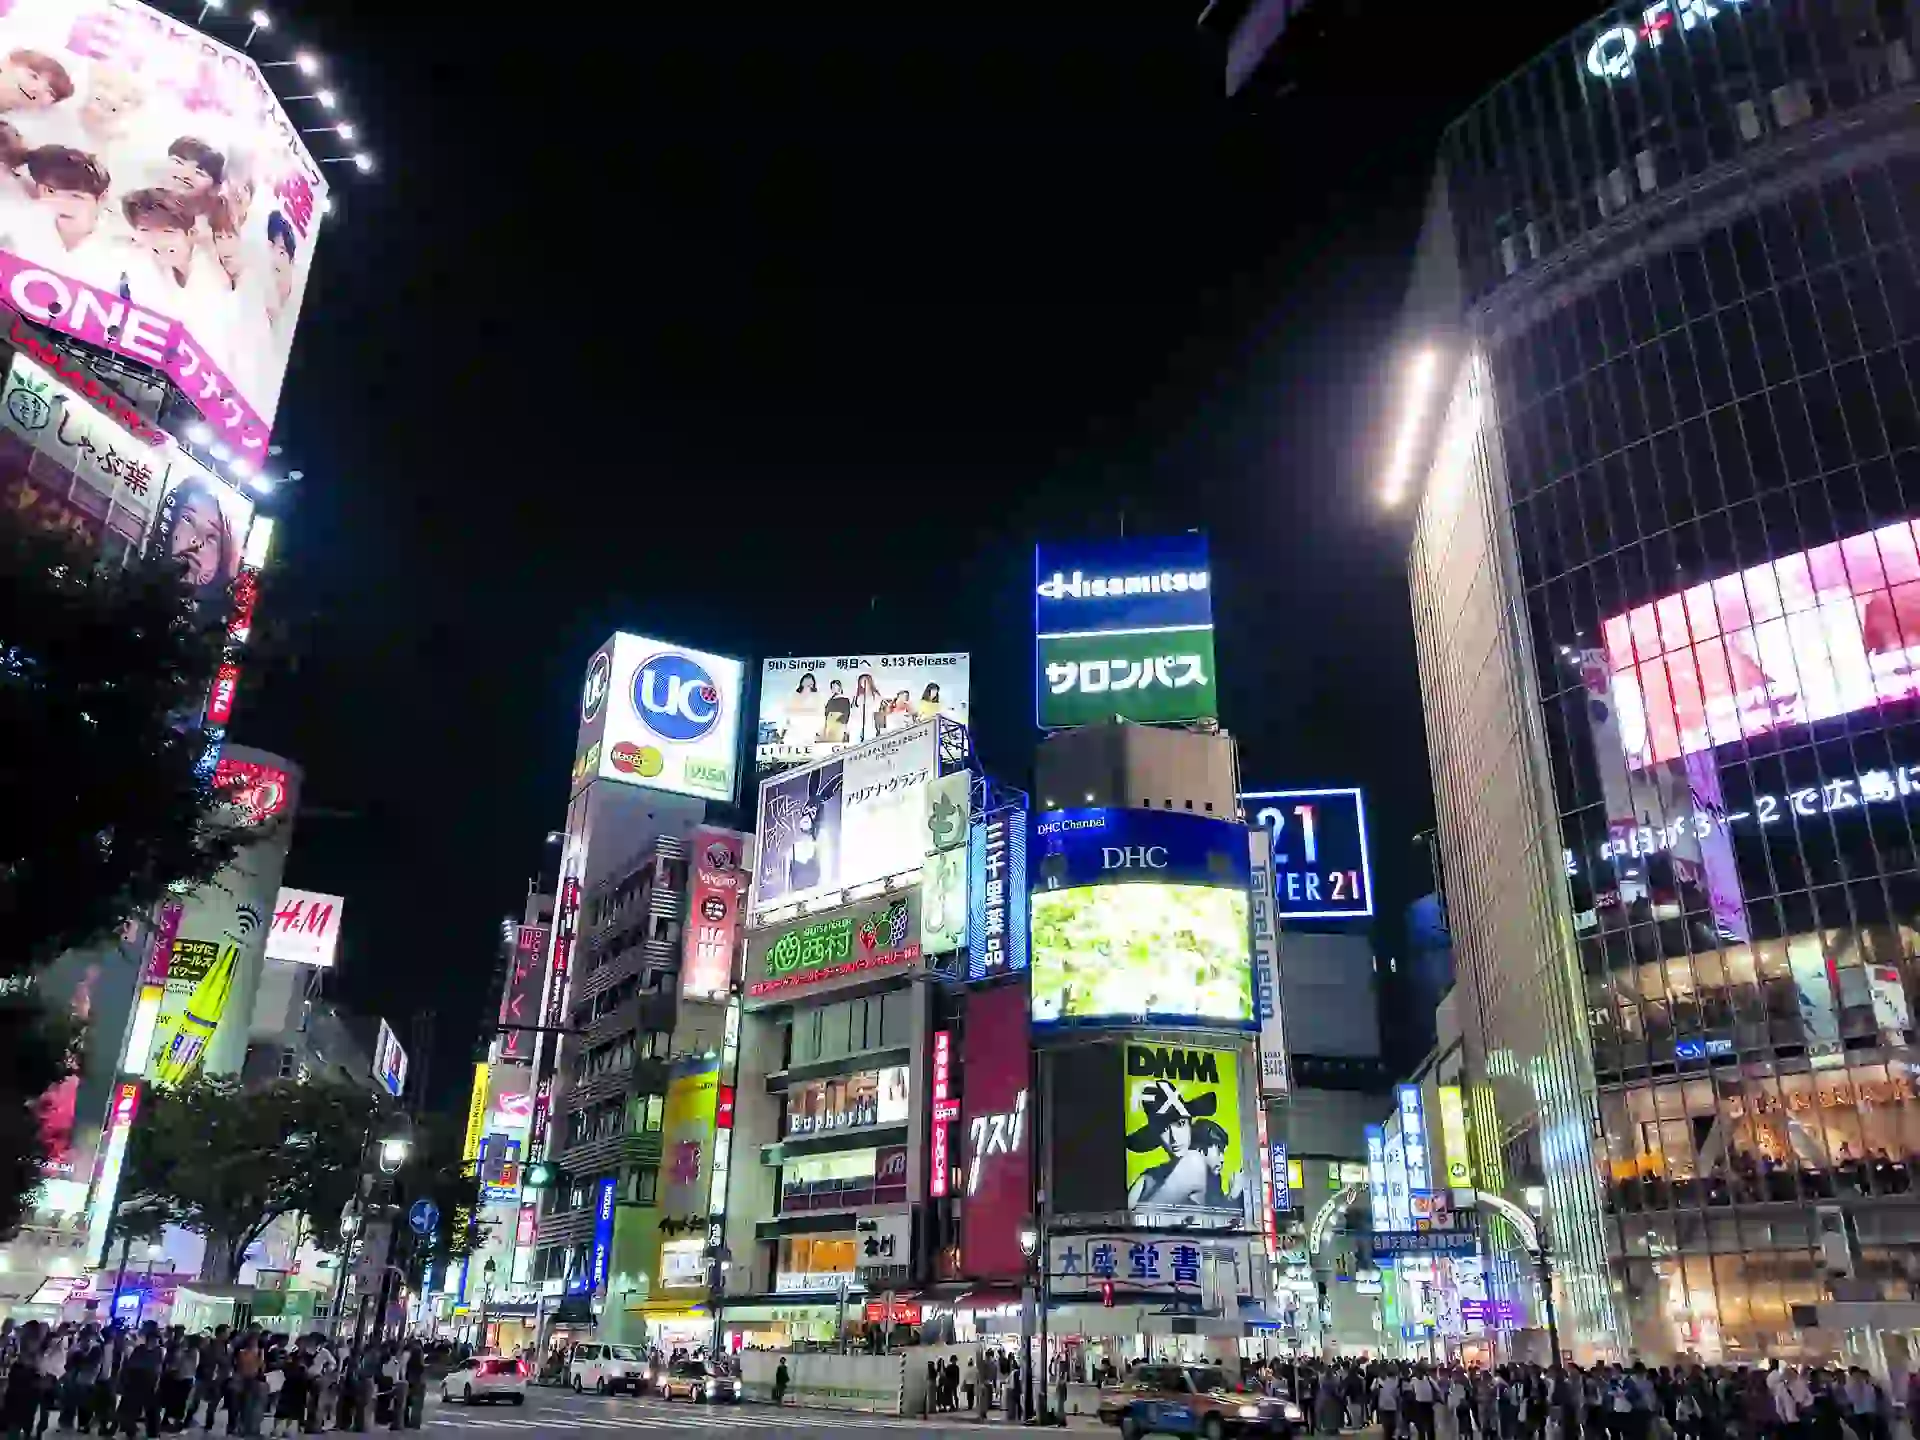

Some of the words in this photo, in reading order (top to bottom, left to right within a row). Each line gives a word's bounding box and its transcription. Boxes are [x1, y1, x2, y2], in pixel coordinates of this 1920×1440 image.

[10, 269, 172, 362] ONE
[1037, 571, 1208, 599] Hisamitsu
[768, 660, 787, 671] 9th
[789, 659, 826, 670] Single
[836, 657, 871, 669] 明日へ
[881, 656, 906, 668] 9.13
[907, 654, 957, 667] Release
[1045, 654, 1209, 694] サロンパス
[639, 668, 719, 723] UC
[760, 745, 812, 756] LITTLE
[691, 766, 727, 783] VISA
[1037, 823, 1061, 836] DHC
[1102, 845, 1169, 870] DHC
[984, 822, 1006, 967] 三千里薬品
[1328, 871, 1360, 901] 21
[272, 899, 334, 938] H&M
[802, 929, 851, 966] 西村
[1127, 1046, 1219, 1083] DMM
[1132, 1079, 1191, 1117] FX
[967, 1087, 1029, 1197] クスリ
